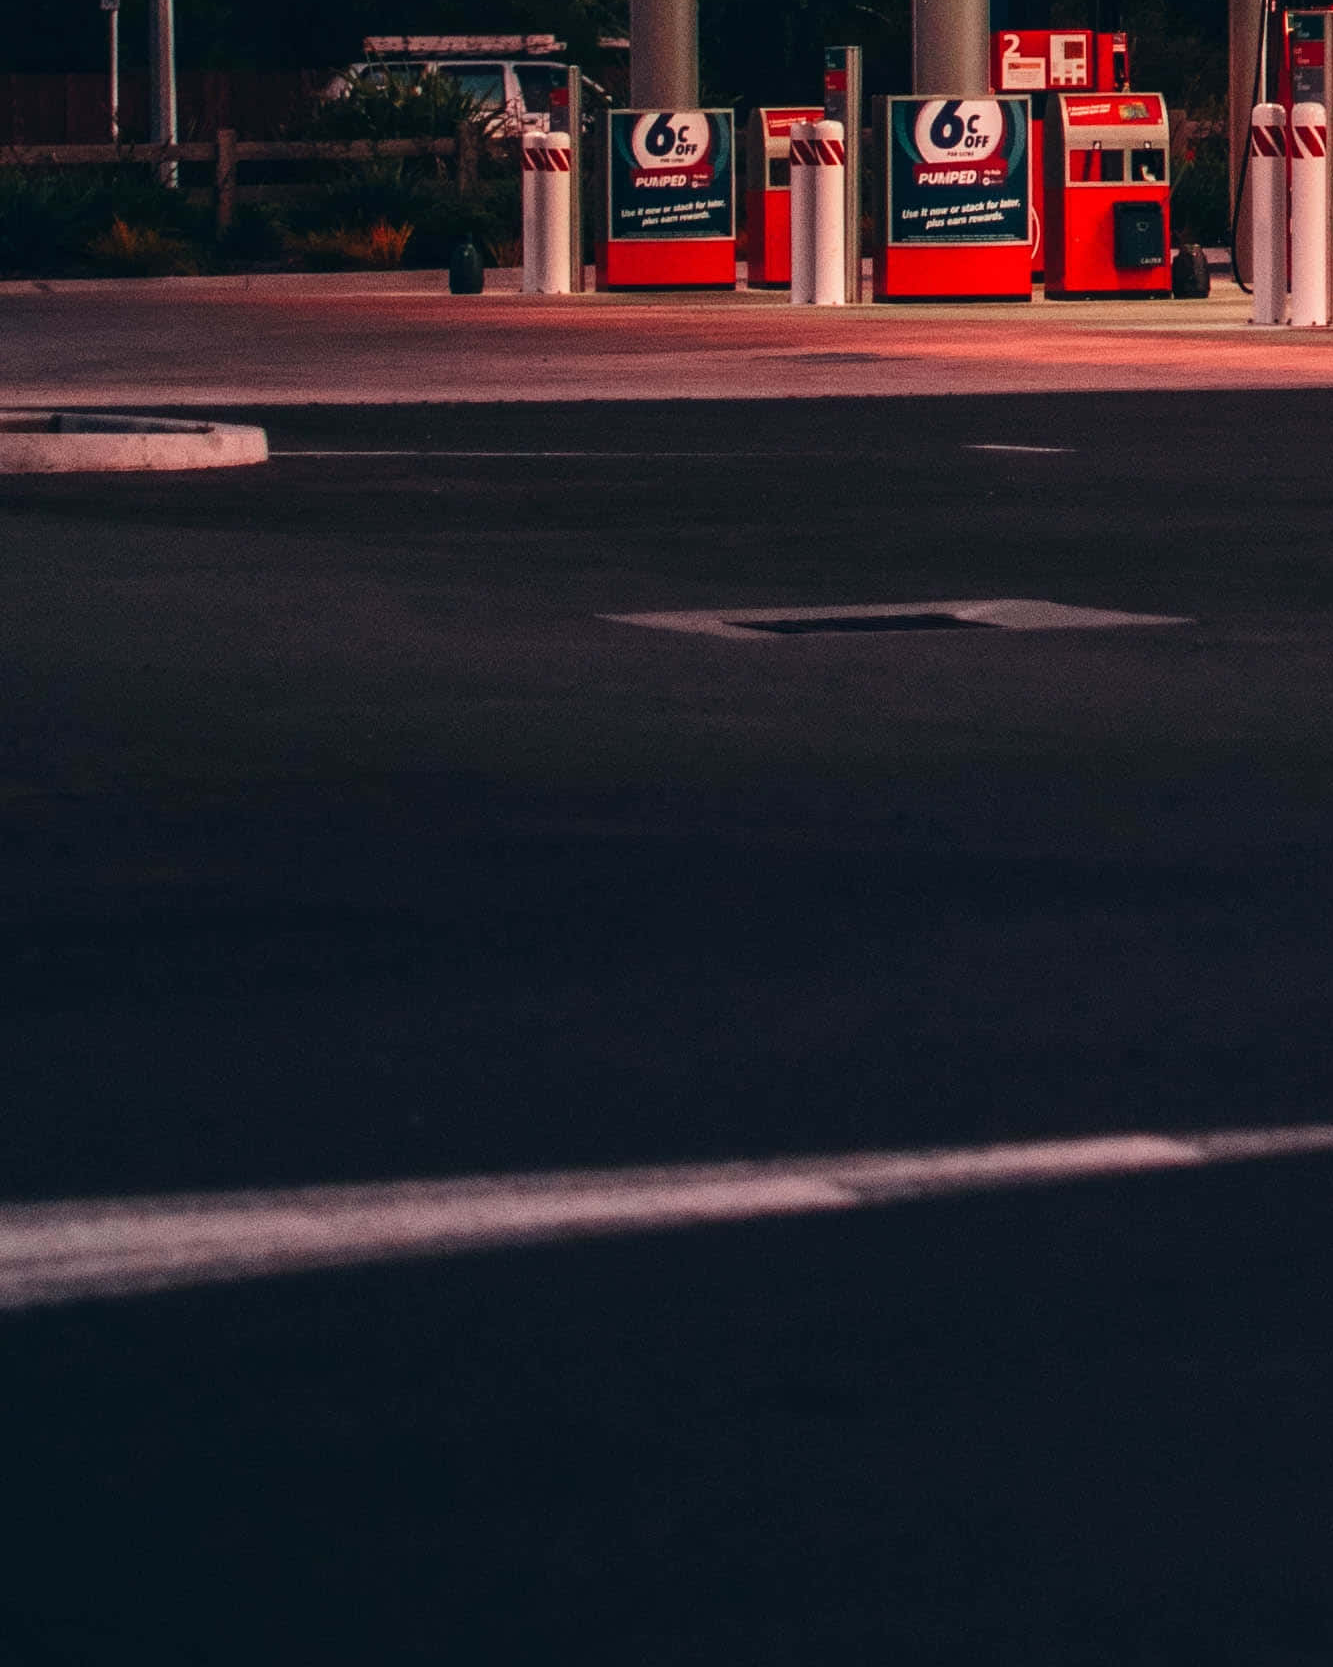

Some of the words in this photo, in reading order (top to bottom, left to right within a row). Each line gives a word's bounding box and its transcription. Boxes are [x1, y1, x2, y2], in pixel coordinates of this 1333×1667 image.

[1003, 34, 1021, 58] 2
[964, 135, 991, 148] OFF
[675, 143, 698, 156] OFF
[635, 174, 688, 188] PUMPED
[917, 169, 978, 185] PUMPED
